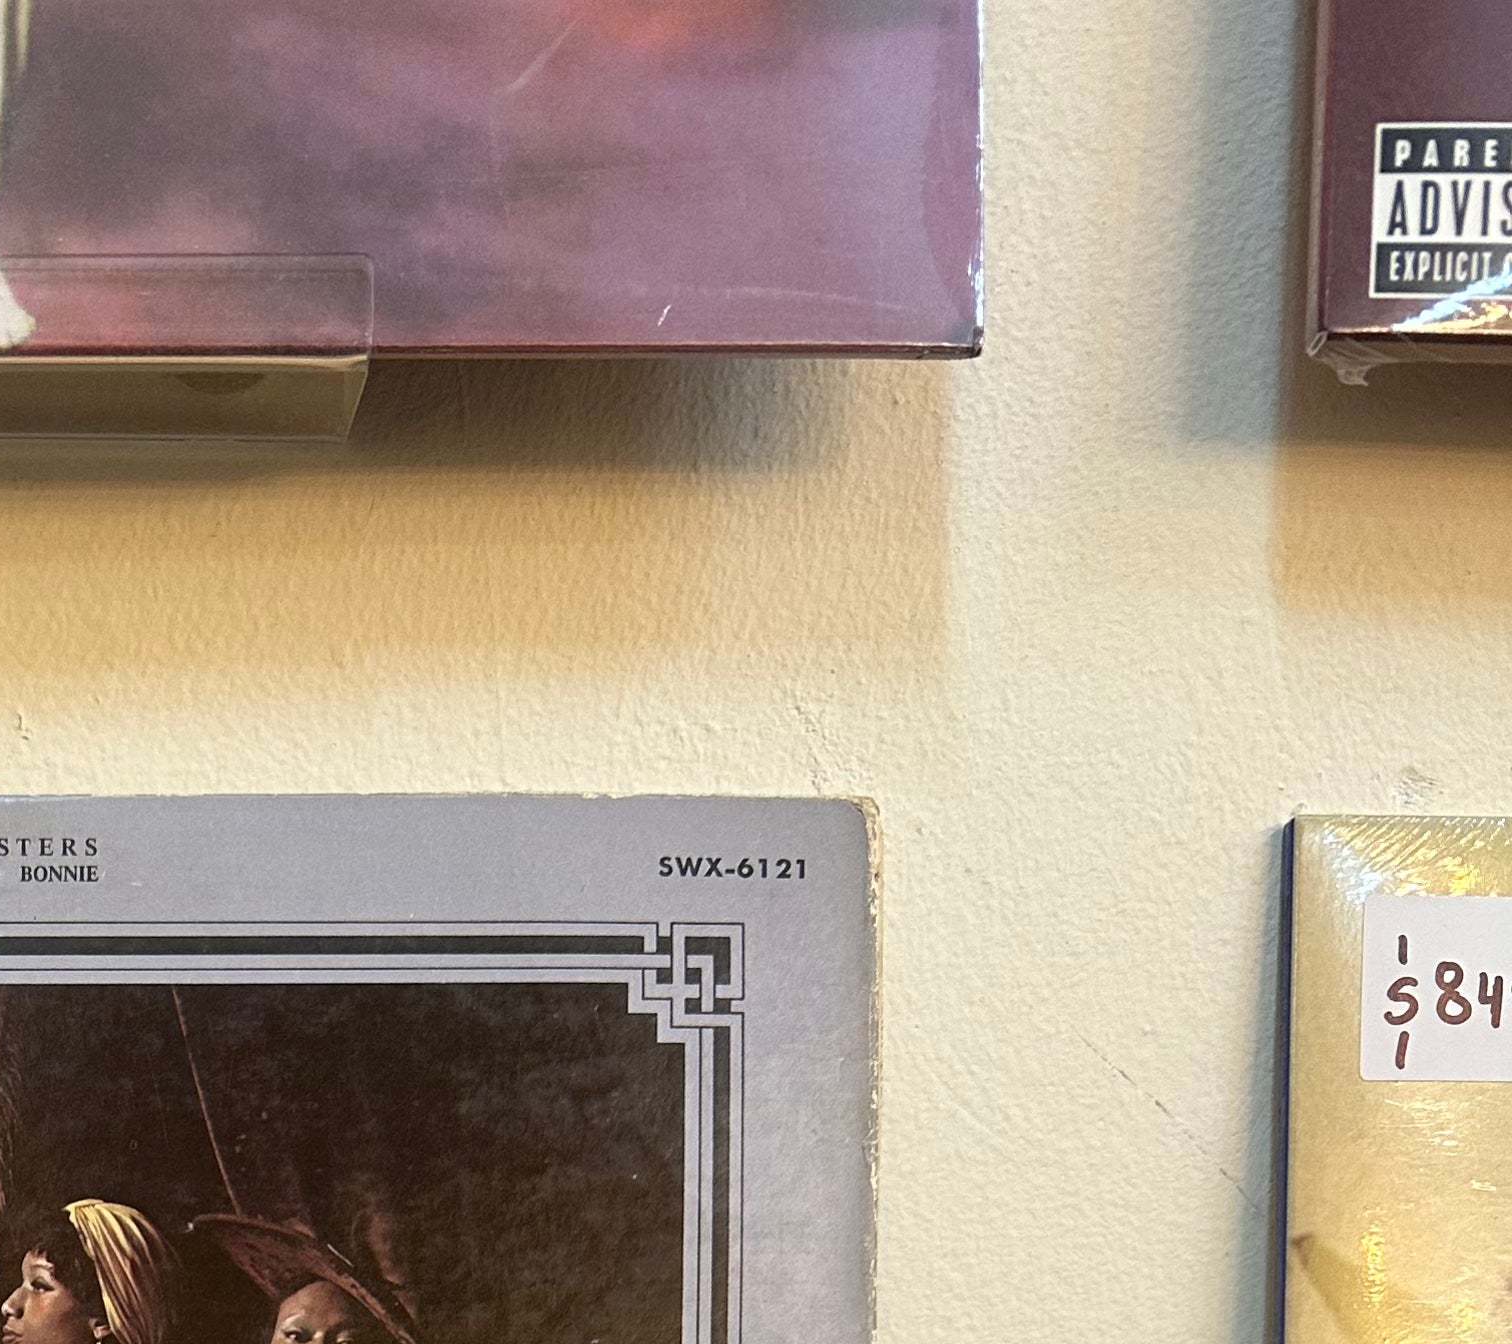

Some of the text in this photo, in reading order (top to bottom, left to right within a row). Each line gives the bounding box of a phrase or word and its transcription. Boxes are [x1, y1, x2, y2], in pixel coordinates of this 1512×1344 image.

[1394, 139, 1512, 167] PARE
[1390, 252, 1490, 281] EXPLICIT
[21, 866, 98, 882] BONNIE
[659, 857, 805, 879] SWX-6121
